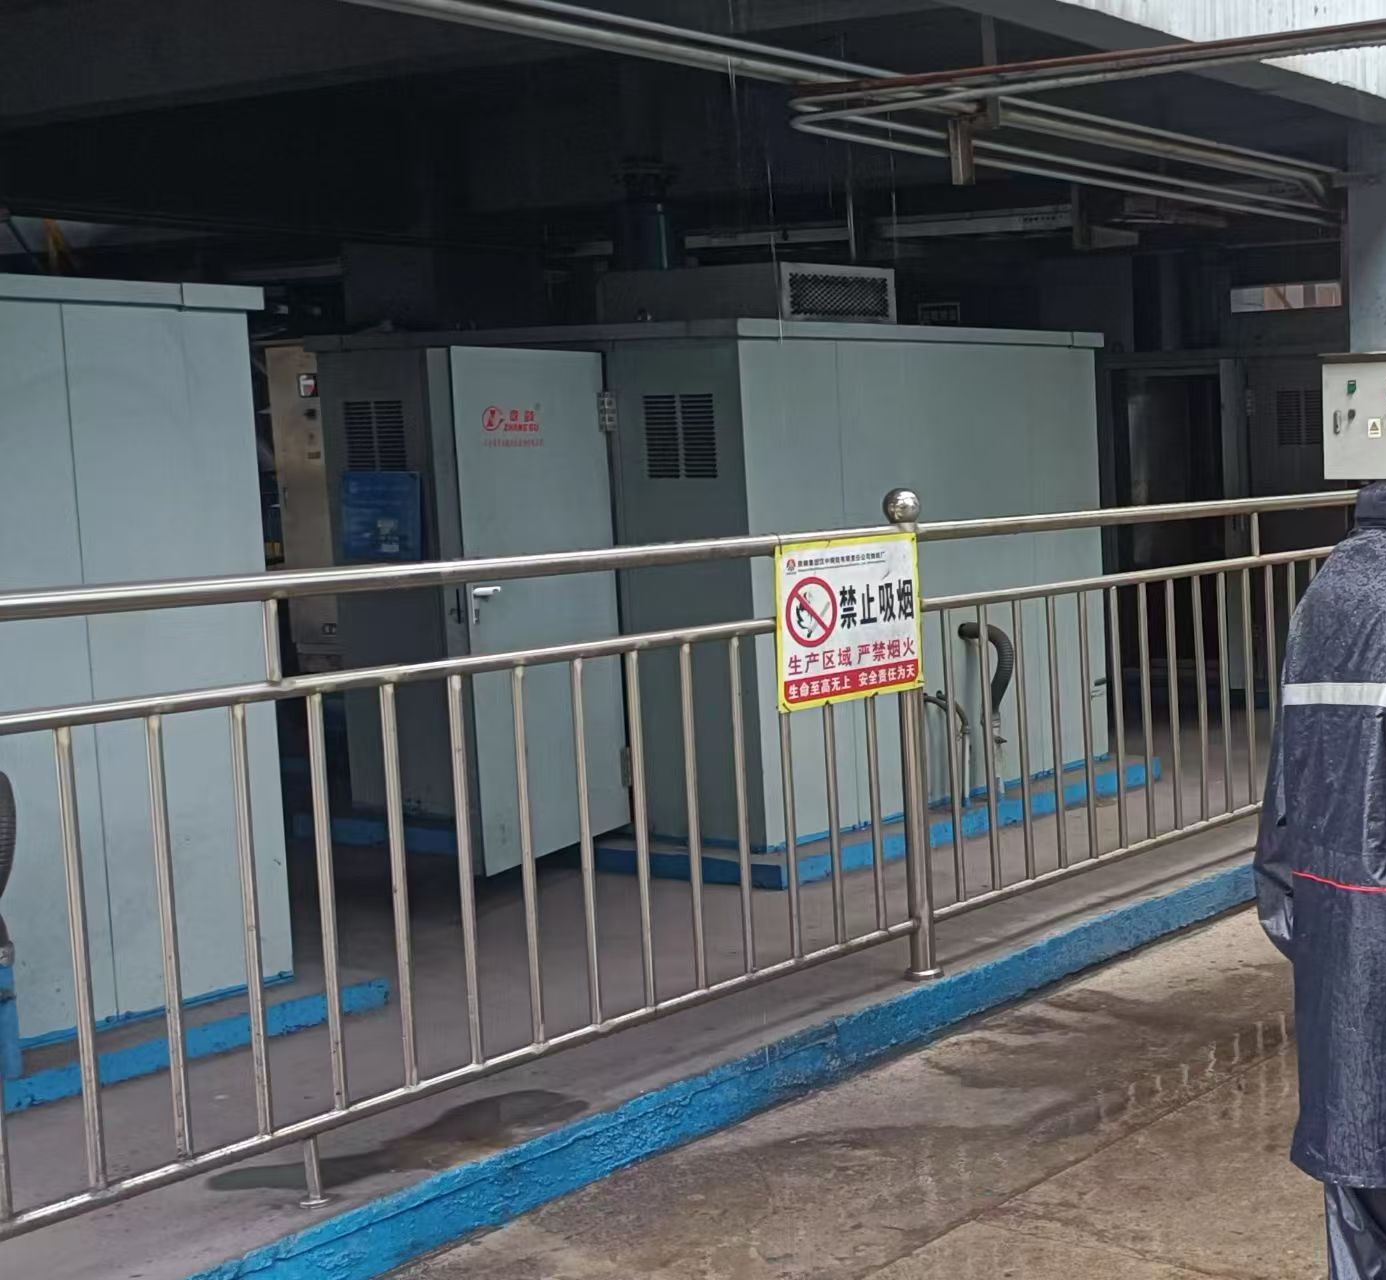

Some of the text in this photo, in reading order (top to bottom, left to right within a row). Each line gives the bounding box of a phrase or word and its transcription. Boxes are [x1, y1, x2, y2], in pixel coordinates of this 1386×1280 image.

[839, 579, 915, 630] 禁止吸烟
[788, 637, 916, 676] 生产区域 严禁烟火
[788, 664, 916, 700] 生命至高无上 安全责任为天
